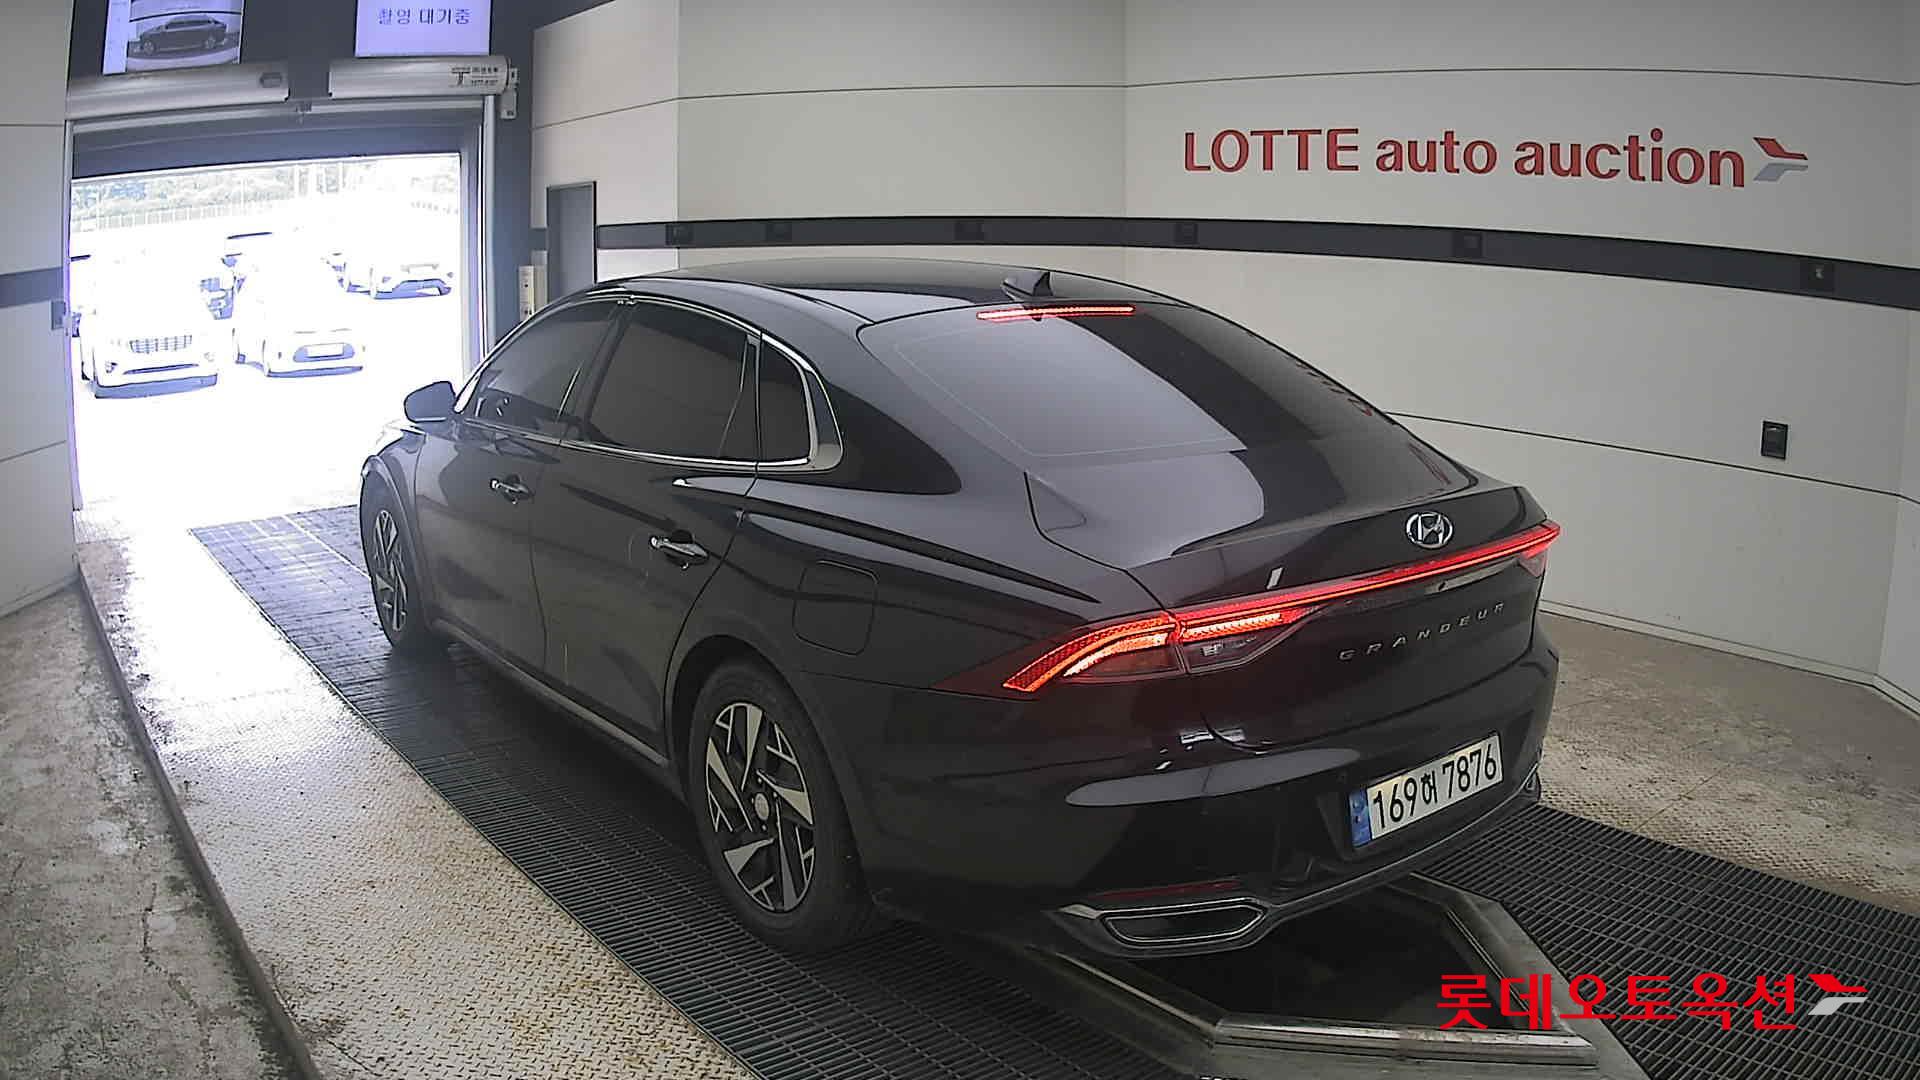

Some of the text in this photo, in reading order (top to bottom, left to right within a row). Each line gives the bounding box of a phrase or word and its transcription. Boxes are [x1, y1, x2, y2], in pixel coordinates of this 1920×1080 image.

[419, 8, 470, 25] 대기중
[1184, 127, 1745, 188] LOTTE auto auction
[1339, 602, 1505, 660] GRANDEUR
[1373, 743, 1497, 829] 169허 7876
